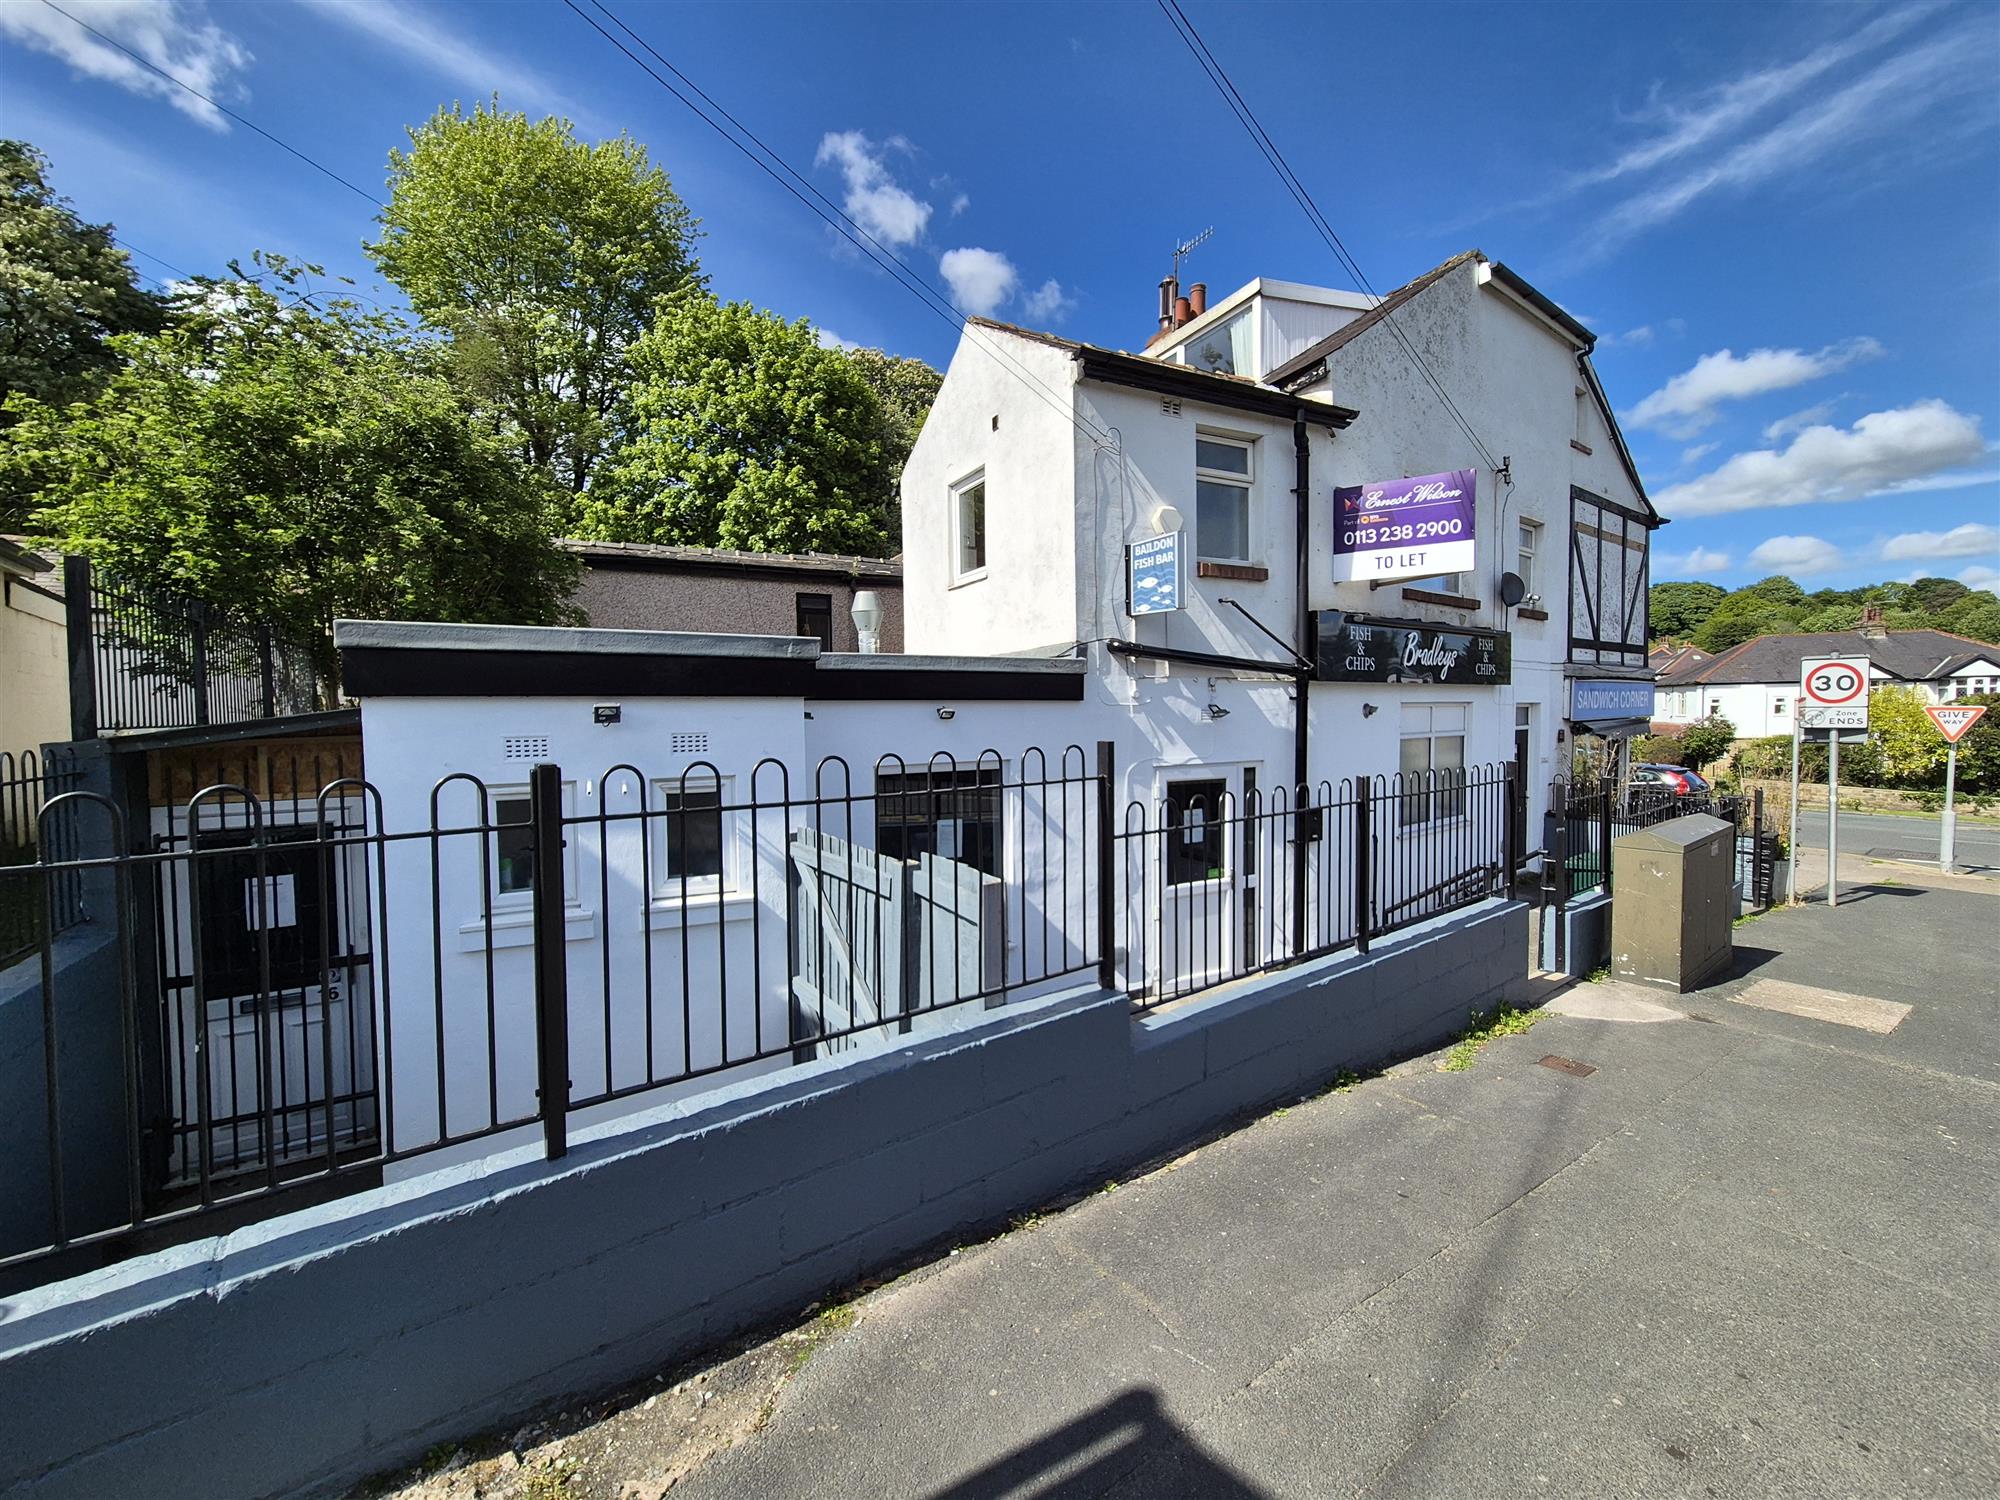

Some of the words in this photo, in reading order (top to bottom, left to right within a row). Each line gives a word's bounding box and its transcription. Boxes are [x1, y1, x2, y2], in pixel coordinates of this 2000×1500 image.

[1365, 490, 1412, 509] Ernest
[1413, 482, 1462, 503] Wilson
[1344, 528, 1377, 546] 0113
[1380, 525, 1413, 542] 238
[1416, 518, 1462, 538] 2900
[1135, 537, 1174, 557] BAILDON
[1134, 557, 1154, 570] FISH
[1156, 551, 1174, 565] BAR
[1375, 555, 1394, 570] TO
[1400, 552, 1427, 567] LET
[1350, 626, 1372, 642] FISH
[1356, 642, 1366, 656] &
[1478, 638, 1494, 651] FISH
[1346, 656, 1376, 672] CHIPS
[1404, 632, 1458, 680] Bradleys
[1483, 651, 1489, 663] &
[1475, 662, 1496, 676] CHIPS
[1814, 674, 1855, 692] 30
[1577, 690, 1619, 709] SANDWICH
[1620, 690, 1649, 708] CORNER
[1829, 717, 1864, 725] ENDS
[1937, 711, 1970, 719] GIVE
